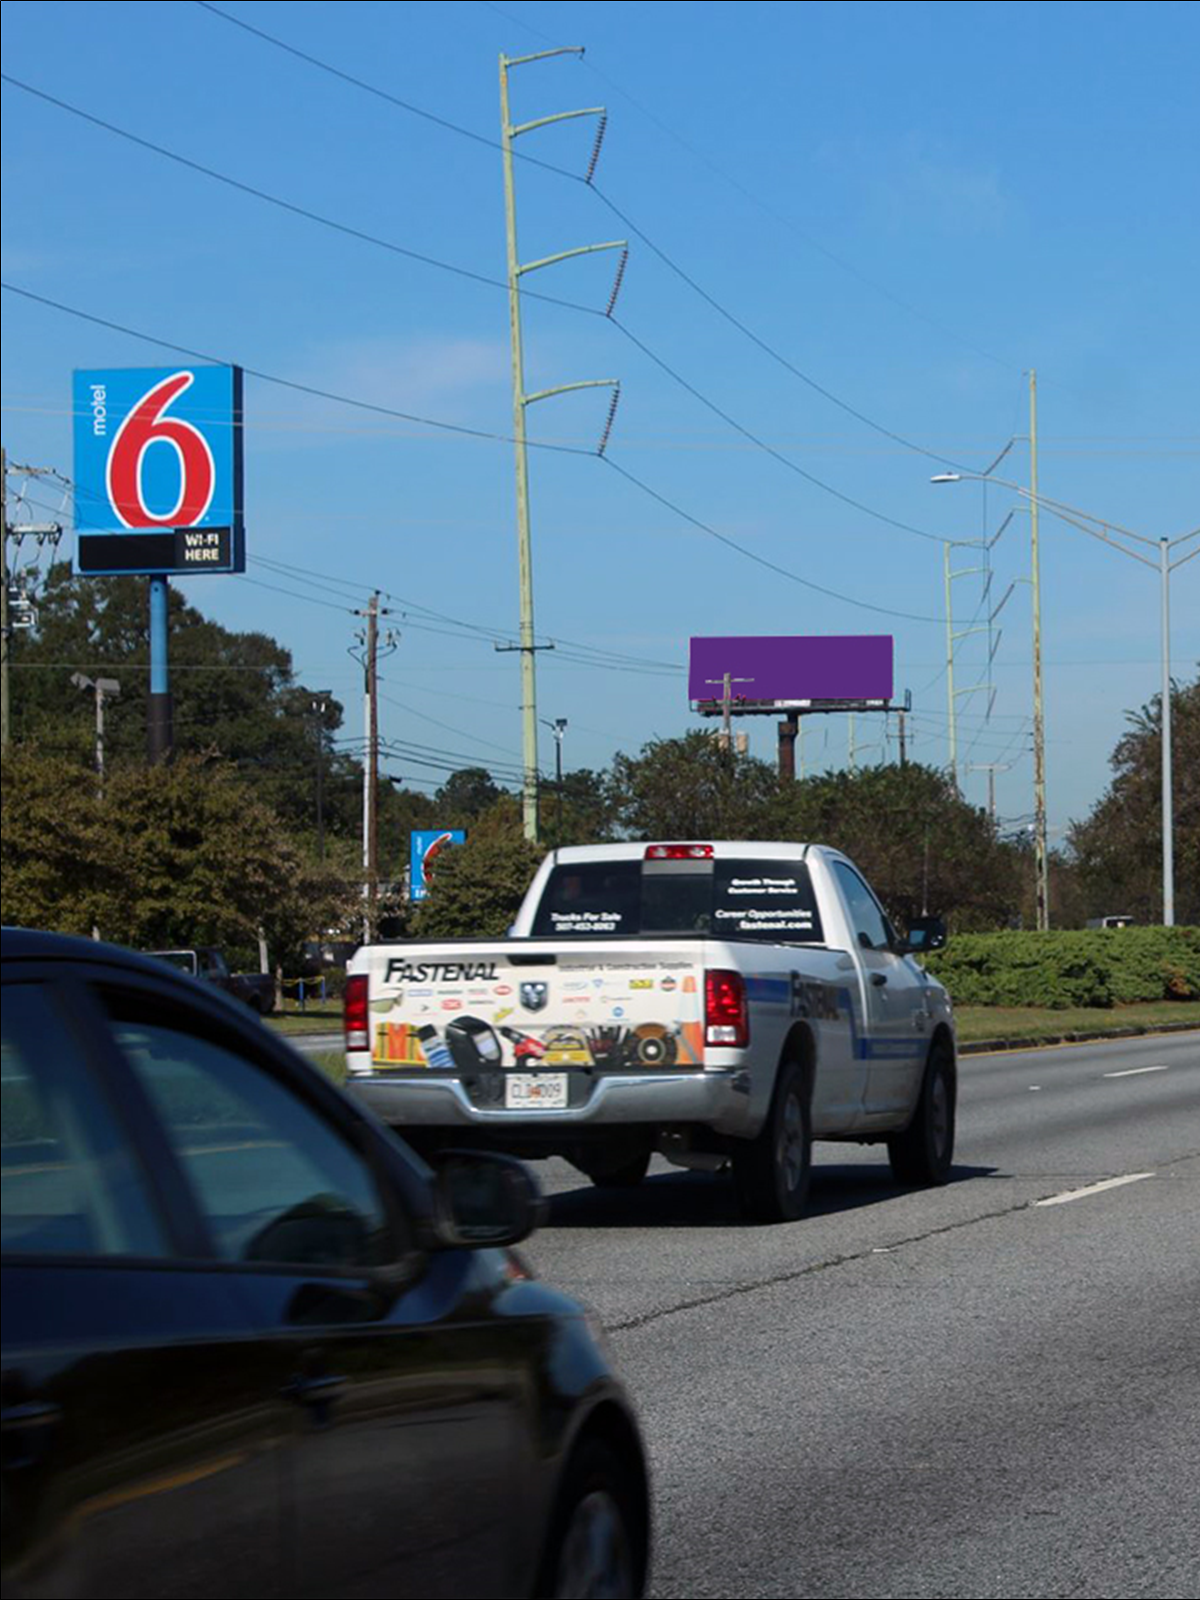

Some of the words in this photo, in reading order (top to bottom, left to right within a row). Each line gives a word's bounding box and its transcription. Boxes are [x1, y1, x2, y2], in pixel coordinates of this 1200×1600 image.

[90, 384, 107, 436] motel
[105, 370, 216, 528] 6
[184, 548, 220, 561] HERE
